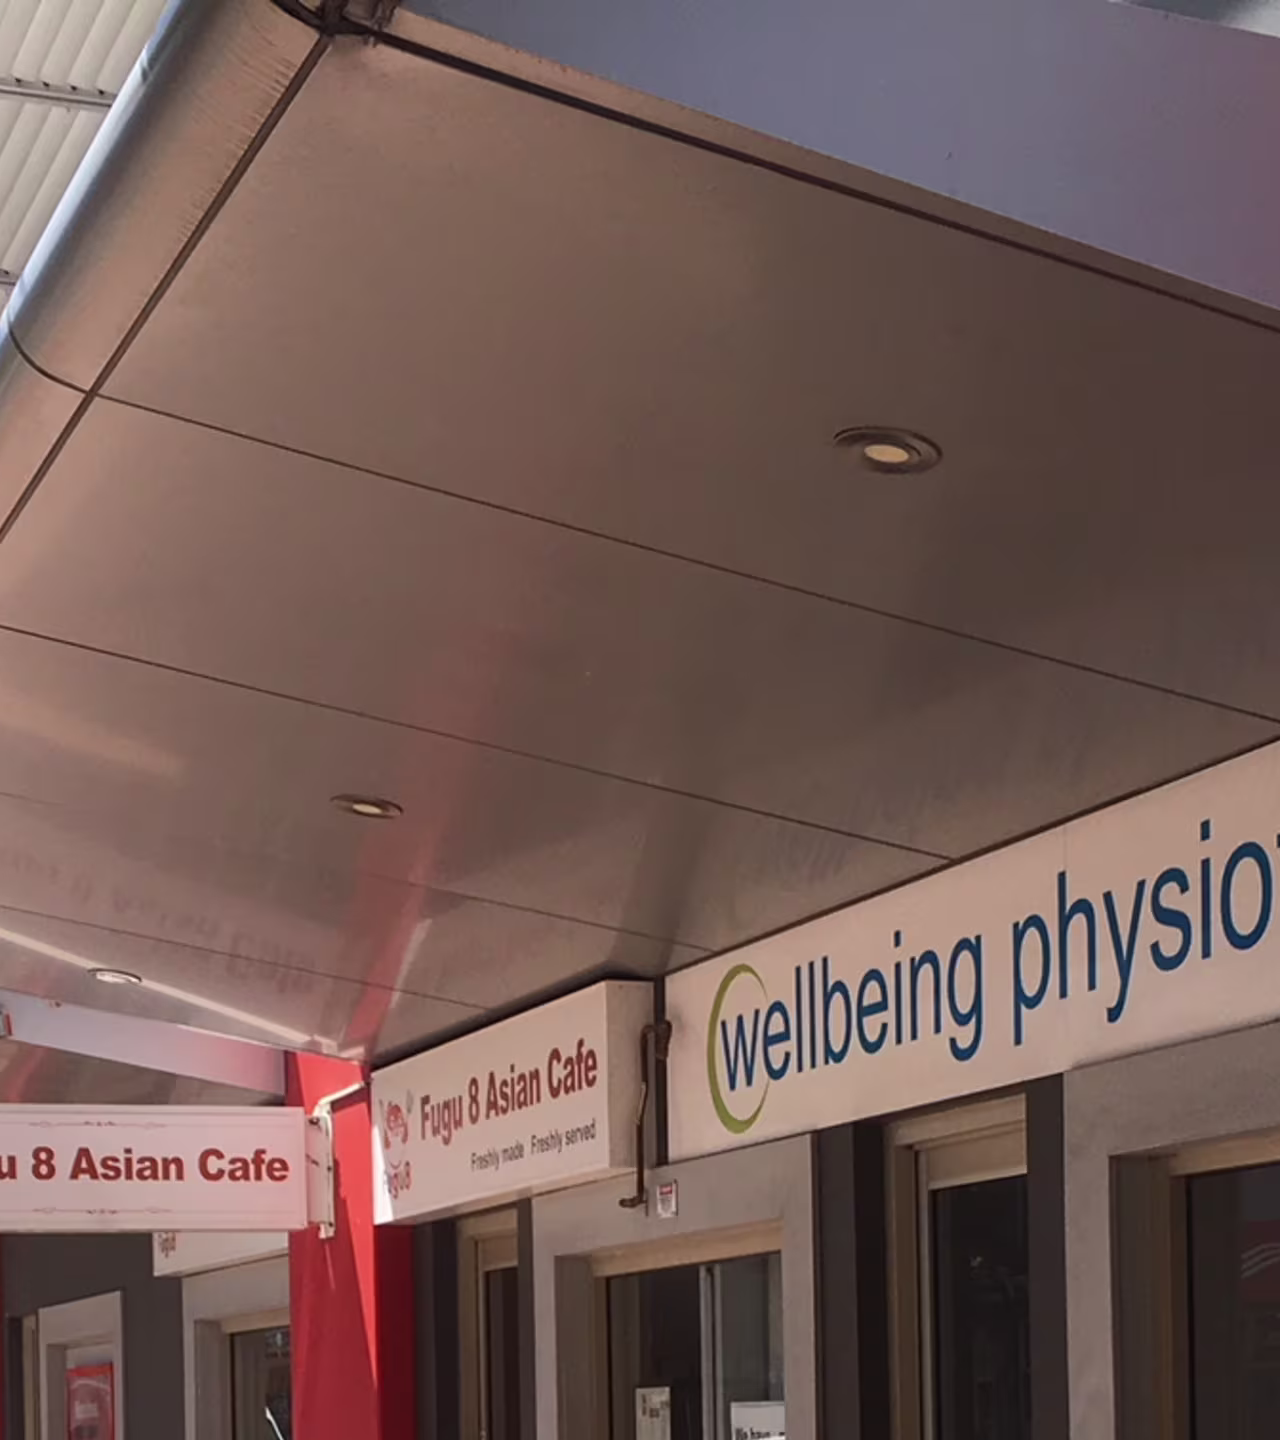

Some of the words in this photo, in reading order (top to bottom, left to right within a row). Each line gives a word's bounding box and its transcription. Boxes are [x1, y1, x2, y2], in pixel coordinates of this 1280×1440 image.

[720, 929, 983, 1092] wellbeing
[420, 1094, 464, 1146] Fugu
[468, 1076, 480, 1125] 8
[484, 1064, 542, 1121] Asian
[547, 1037, 598, 1100] Cafe
[31, 1145, 56, 1181] 8
[69, 1146, 185, 1182] Asian
[197, 1148, 290, 1182] Cafe
[471, 1146, 500, 1172] Freshly
[501, 1139, 525, 1163] made
[530, 1129, 563, 1155] Freshly
[564, 1117, 597, 1147] served
